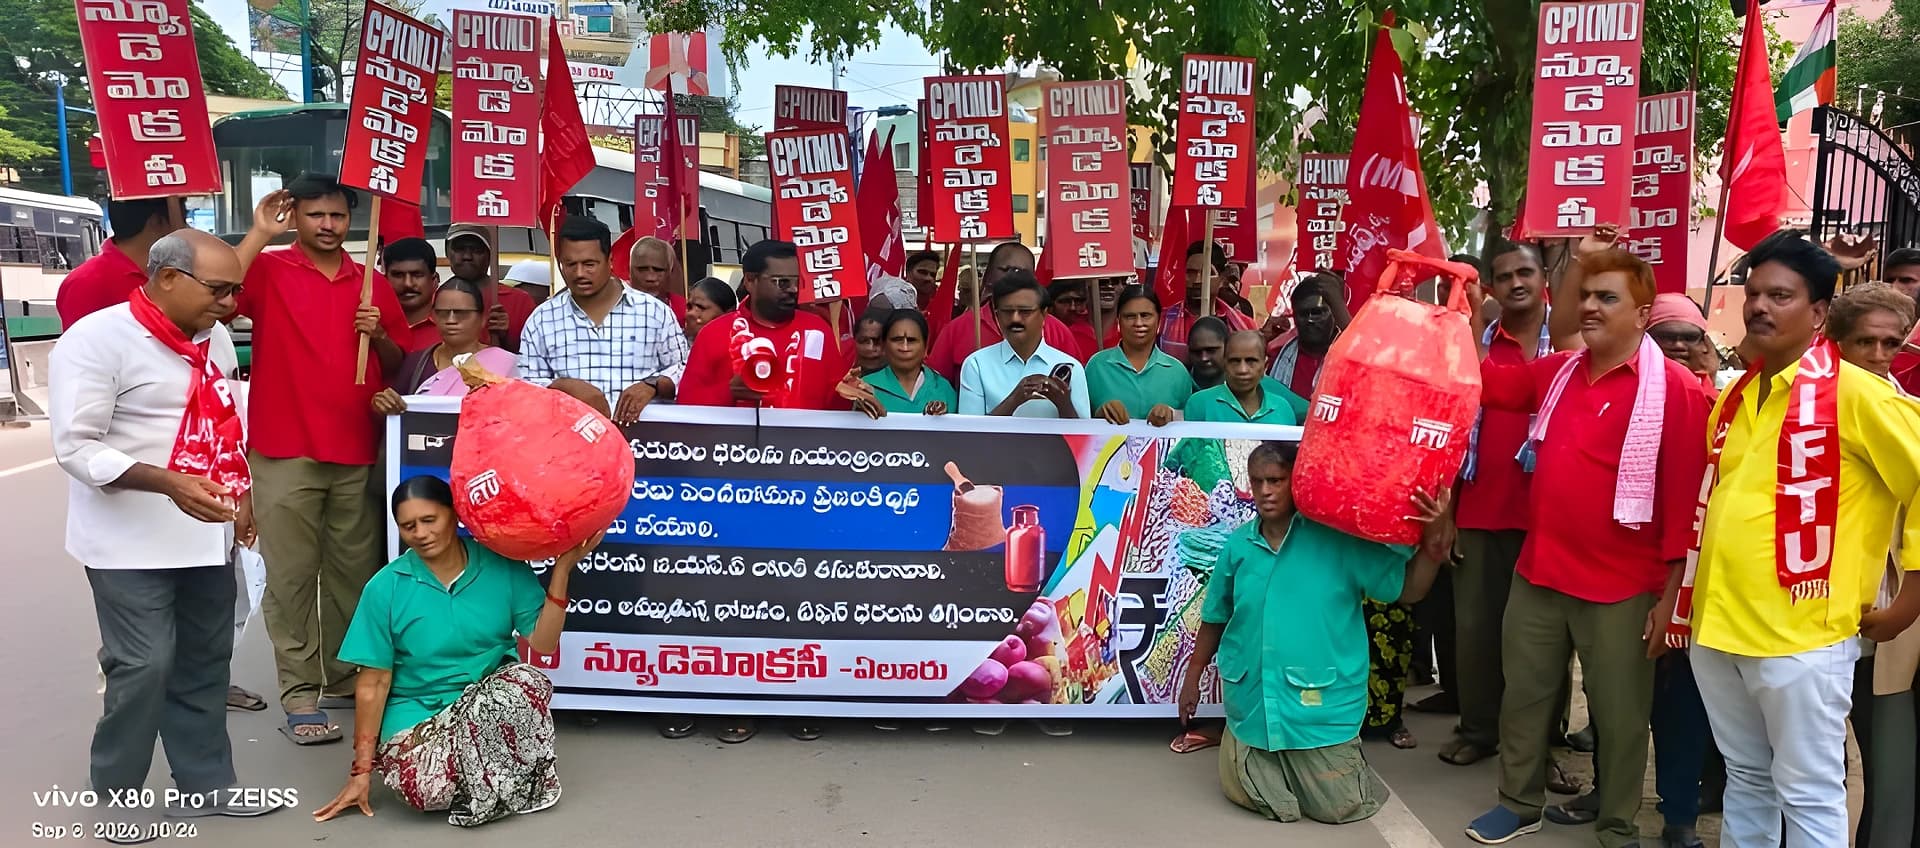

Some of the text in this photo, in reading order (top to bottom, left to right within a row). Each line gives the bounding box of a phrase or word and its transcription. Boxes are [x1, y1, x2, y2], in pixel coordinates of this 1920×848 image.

[366, 10, 440, 74] CPI(ML)
[457, 14, 534, 52] CPI(ML)
[1544, 3, 1639, 45] CPI(ML)
[1184, 58, 1253, 96] CPI(ML)
[930, 80, 1003, 120] CPI(ML)
[1050, 83, 1120, 117] CPI(ML)
[770, 132, 847, 177] CPI(ML)
[1410, 425, 1449, 449] IFTU
[1785, 383, 1832, 574] IFTU
[584, 643, 827, 686] న్యూడెమోక్రసీ
